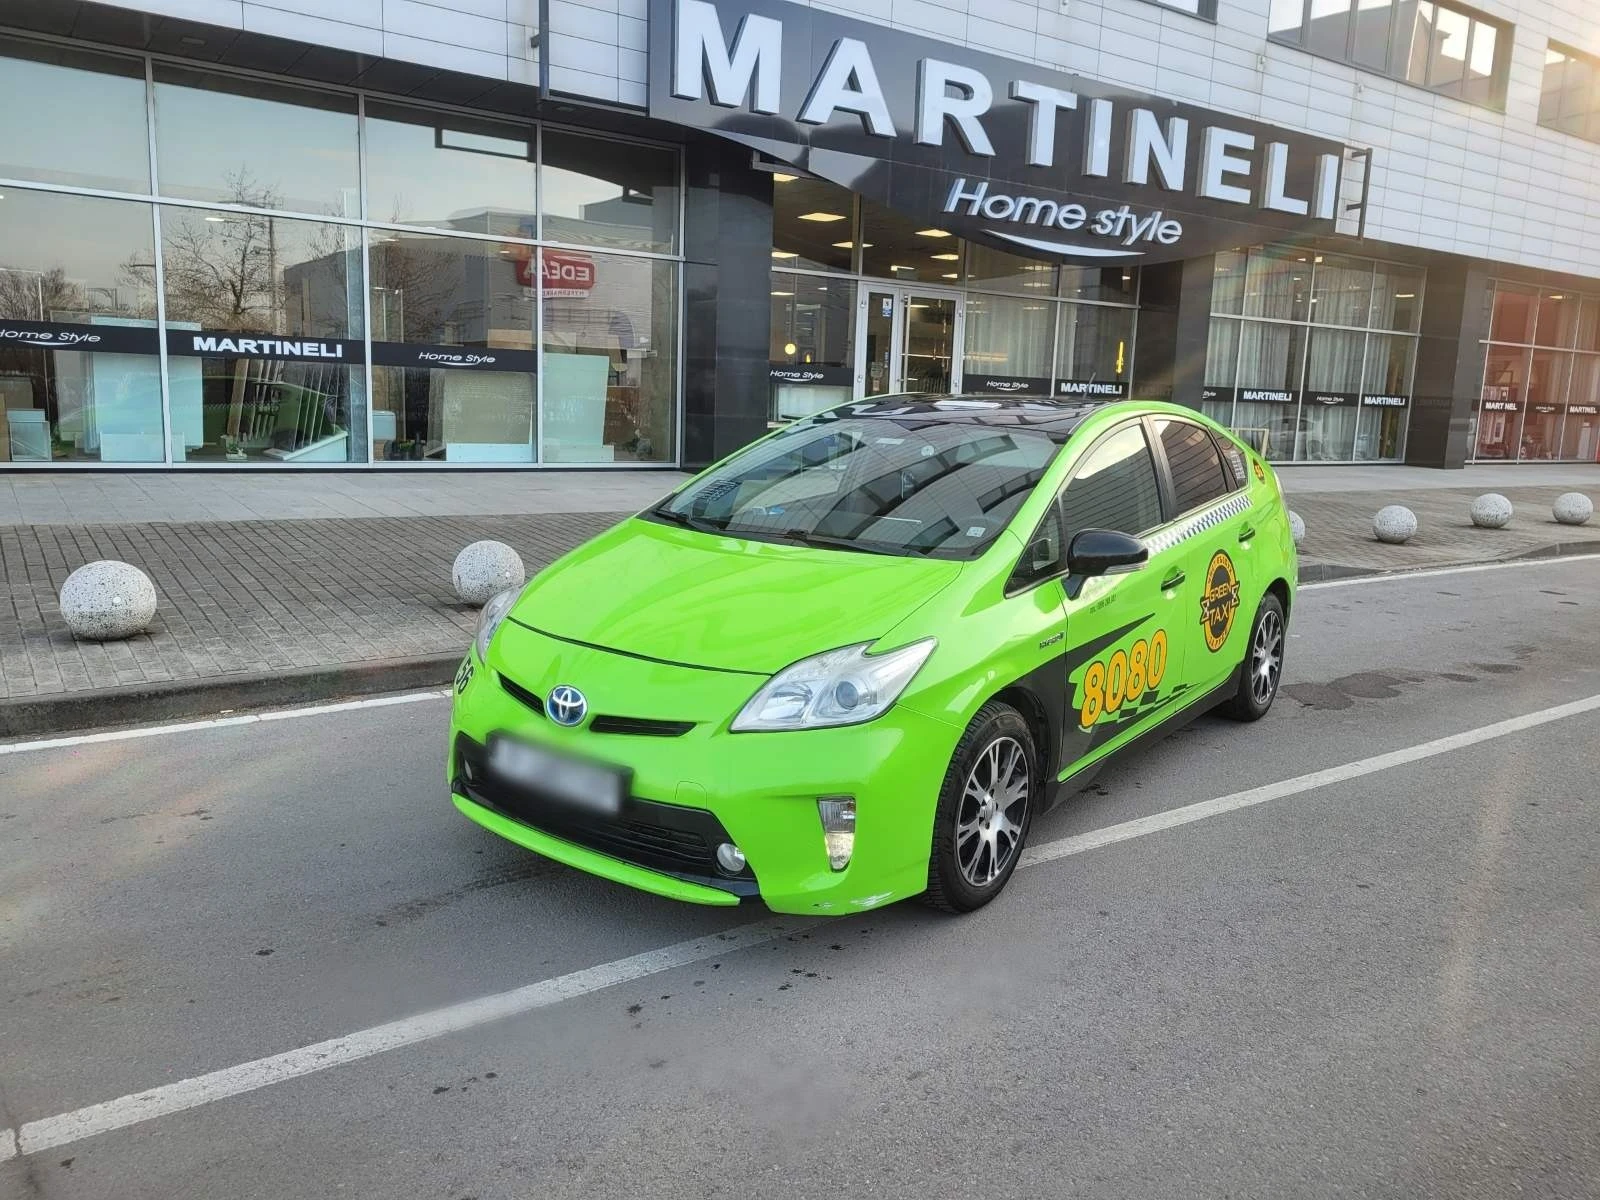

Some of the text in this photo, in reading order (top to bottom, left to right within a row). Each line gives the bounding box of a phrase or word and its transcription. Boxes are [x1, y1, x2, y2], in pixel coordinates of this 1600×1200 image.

[671, 0, 1339, 221] MARTINELI
[944, 177, 1183, 246] Home style
[58, 332, 101, 343] Style
[193, 336, 343, 358] MARTINELI
[418, 351, 496, 364] Home Style
[770, 369, 824, 380] Home Style
[1060, 382, 1122, 395] MARTINELI
[1243, 390, 1293, 402] MARTINELI
[1364, 396, 1406, 406] MARTINELI
[1485, 401, 1518, 411] MARTNEL
[1569, 405, 1598, 414] MARTINEL
[1209, 582, 1232, 602] GREEN
[1209, 599, 1232, 627] TAXI
[1079, 628, 1168, 729] 8080
